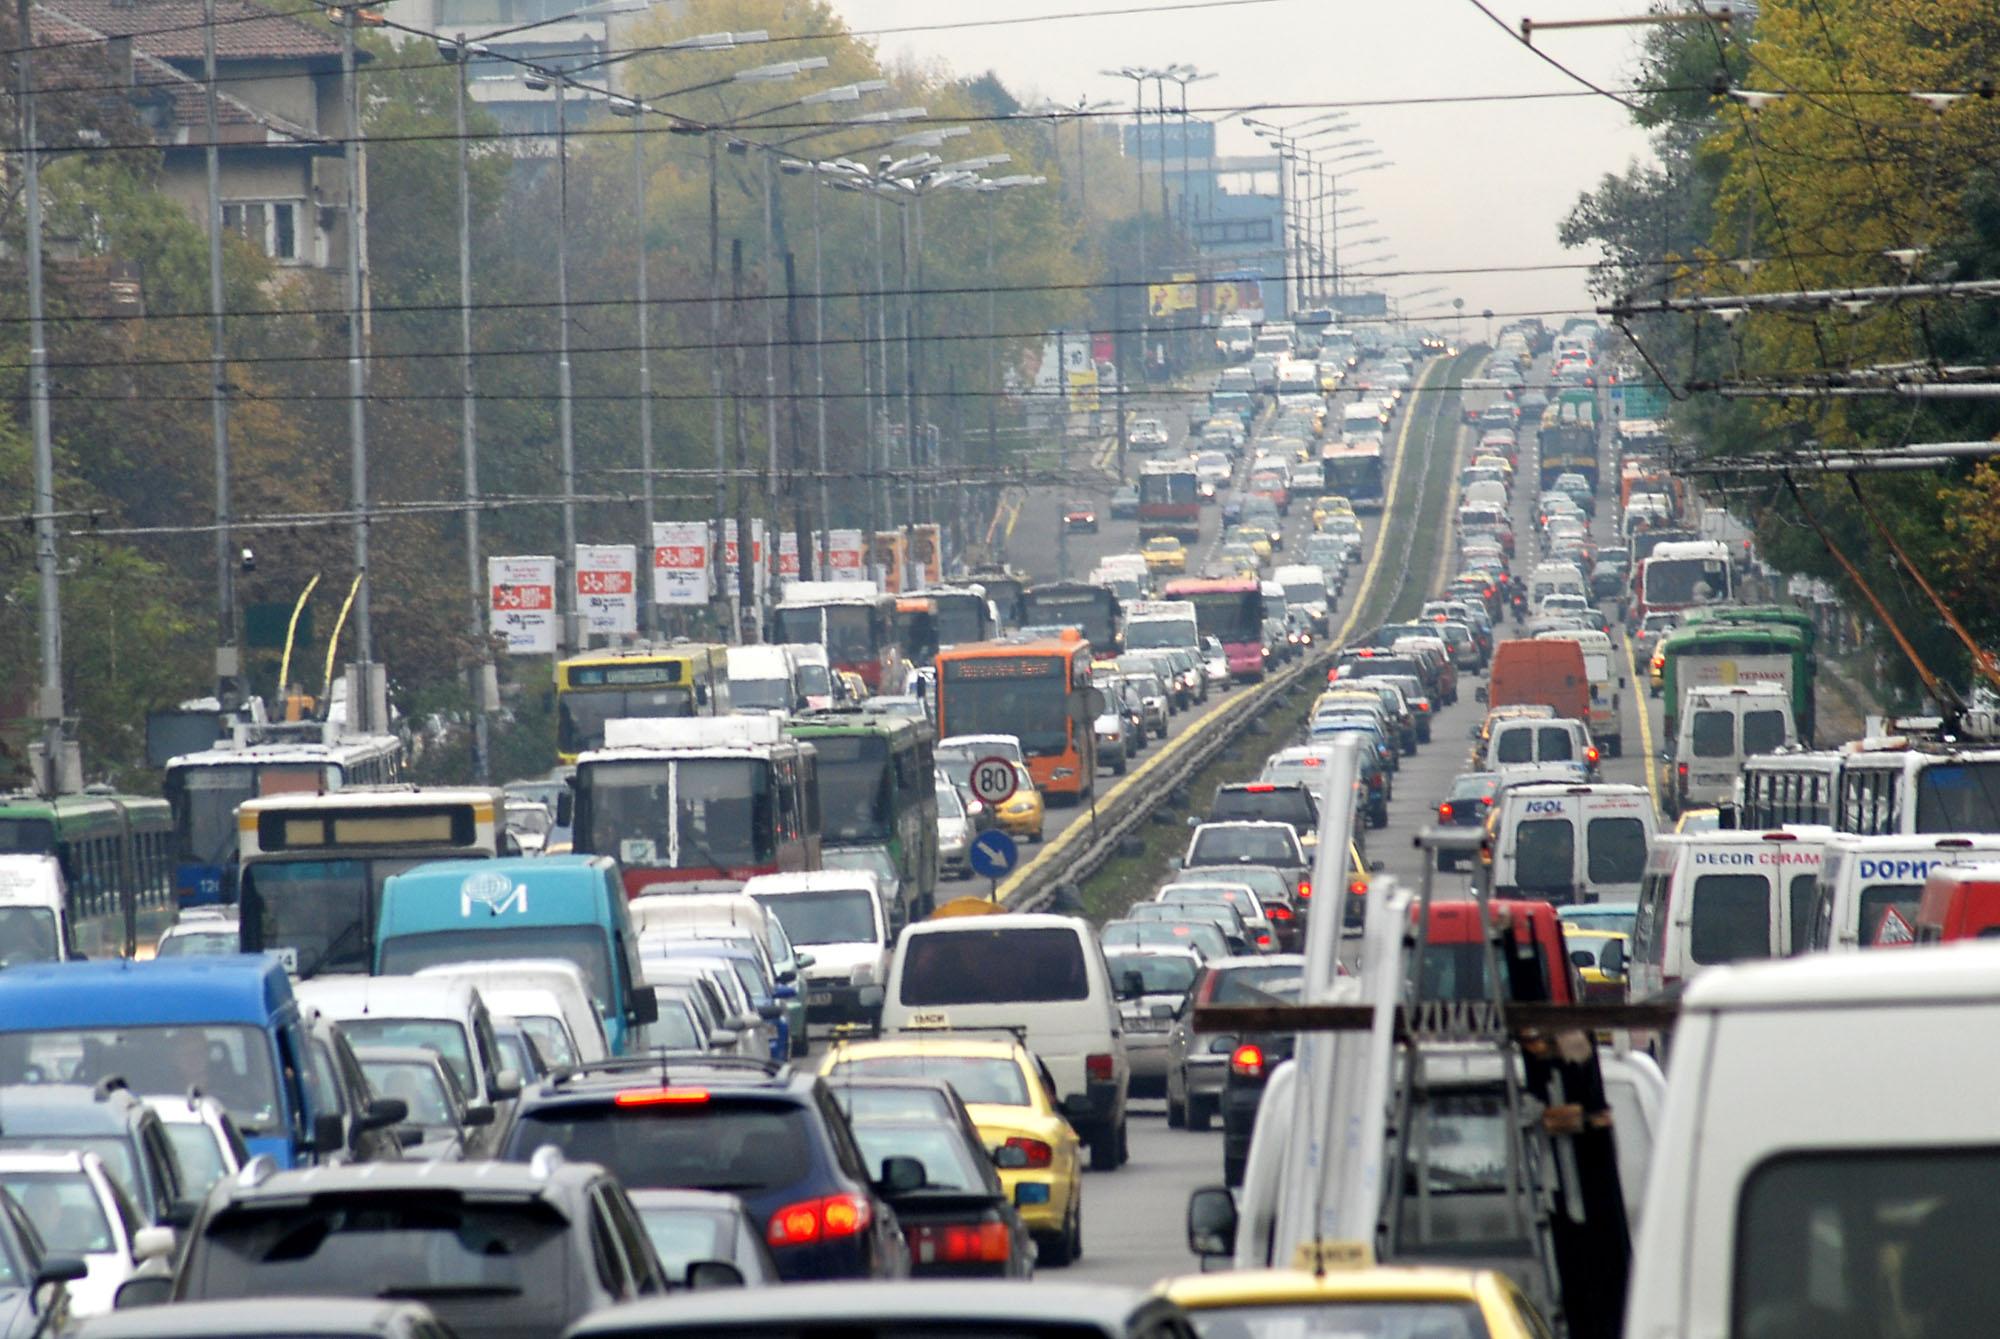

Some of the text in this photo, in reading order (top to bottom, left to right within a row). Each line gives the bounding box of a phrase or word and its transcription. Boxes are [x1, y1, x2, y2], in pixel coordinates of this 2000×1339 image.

[981, 768, 1007, 793] 80
[1525, 801, 1566, 813] IGOL
[1696, 852, 1754, 865] DECOR
